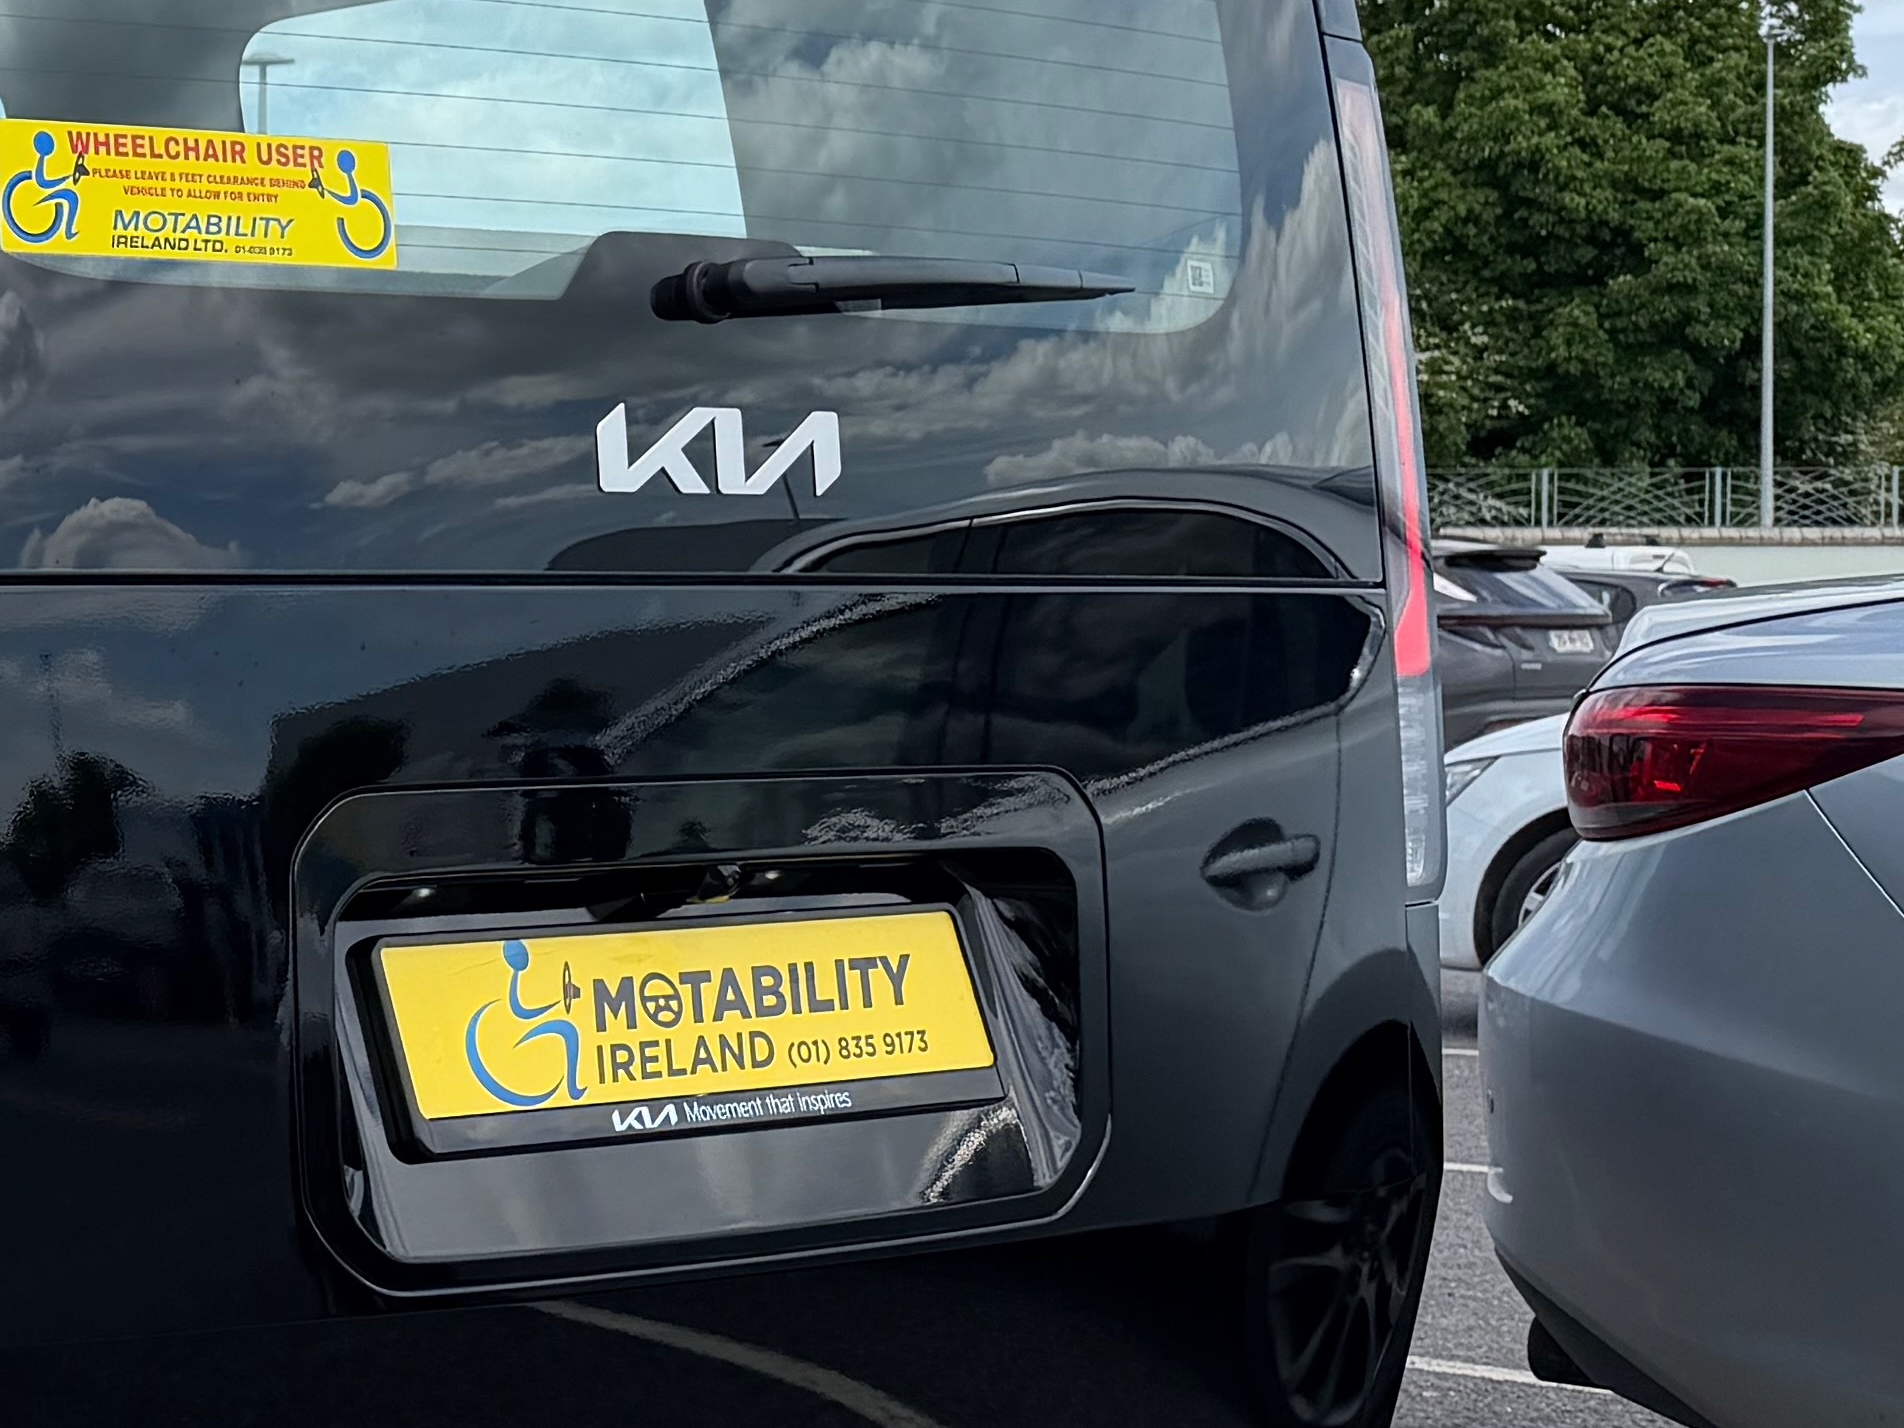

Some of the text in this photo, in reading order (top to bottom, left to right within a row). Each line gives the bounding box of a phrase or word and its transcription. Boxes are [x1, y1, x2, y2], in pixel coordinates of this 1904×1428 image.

[67, 130, 324, 169] WHEELCHAIR USER
[92, 168, 132, 180] PLEASE
[134, 170, 168, 182] LEAVE
[178, 172, 204, 184] FEET
[206, 174, 267, 187] CLEARANCE
[123, 185, 279, 204] VEHICLE TO ALLOW FOR ENTRY
[112, 209, 296, 240] MOTABILITY
[111, 234, 190, 251] IRELAND
[193, 238, 229, 254] LTD.
[596, 402, 842, 497] KIA
[596, 1029, 929, 1084] IRELAND (01) 835 9173
[611, 1090, 852, 1132] KIA Movement that inspires
